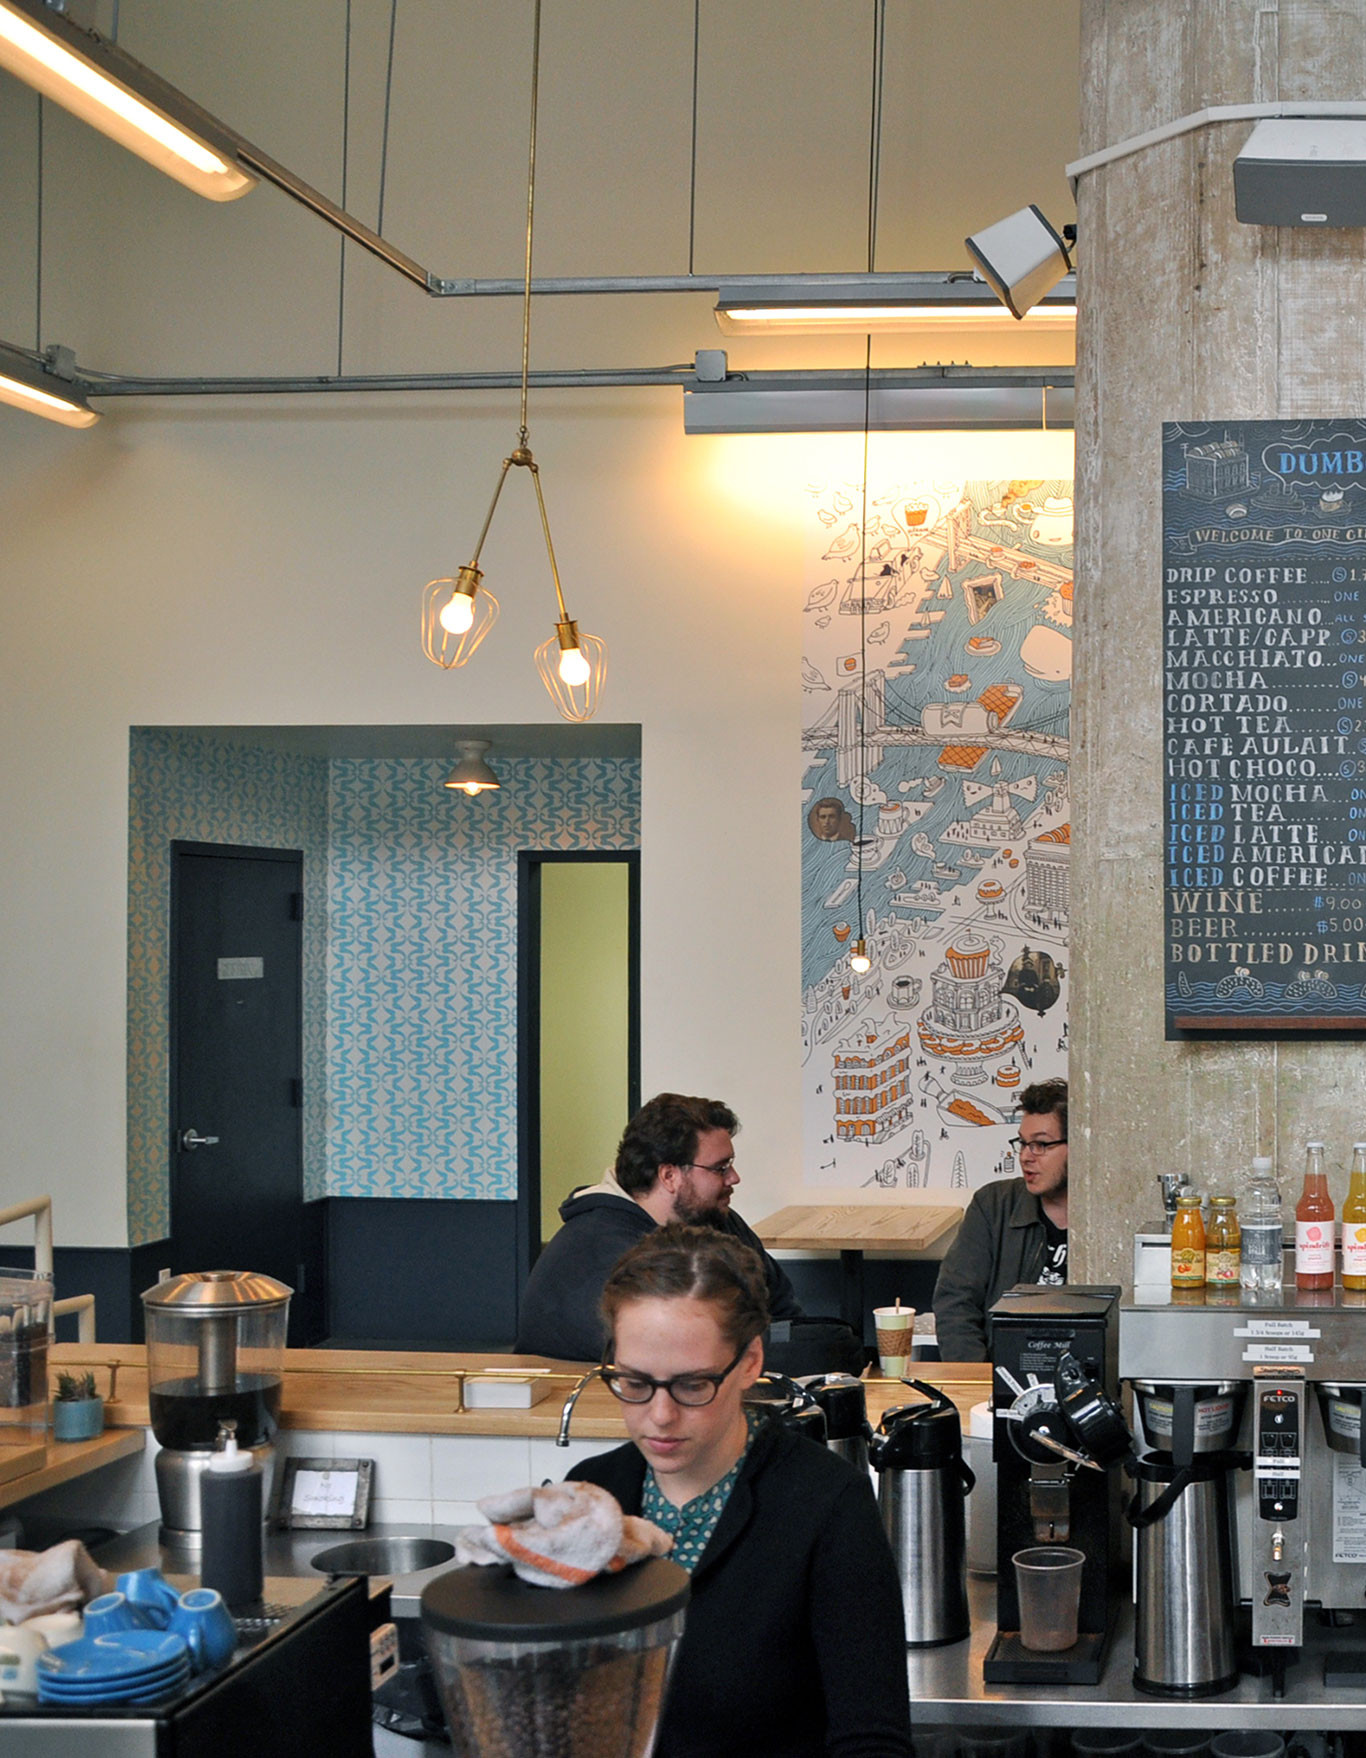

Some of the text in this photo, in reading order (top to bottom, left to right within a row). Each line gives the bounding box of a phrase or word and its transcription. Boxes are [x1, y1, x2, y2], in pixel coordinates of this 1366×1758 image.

[1195, 529, 1275, 542] WELCOME
[1312, 529, 1339, 540] ONE
[1166, 568, 1216, 583] DRIP
[1224, 567, 1307, 584] COFFEE
[1166, 589, 1278, 605] ESPRESSO
[1334, 590, 1360, 602] ONE
[1167, 608, 1322, 626] AMERICANO
[1335, 613, 1356, 623] ALL
[1166, 628, 1331, 647] LATTE/CAPP
[1166, 650, 1322, 668] MACCHIATO
[1339, 653, 1365, 664] ONE
[1166, 671, 1269, 690] MOCHA
[1166, 693, 1288, 713] CORTADO
[1338, 696, 1363, 710] ONE
[1166, 717, 1224, 734] HOT
[1236, 716, 1293, 734] TEA
[1168, 759, 1221, 778] HOT
[1229, 758, 1316, 777] CHOCO
[1170, 783, 1224, 801] ICED
[1231, 784, 1329, 803] MOCHA
[1170, 803, 1223, 822] ICED
[1231, 804, 1287, 822] TEA
[1170, 825, 1225, 843] ICED
[1233, 824, 1319, 844] LATTE
[1167, 845, 1224, 864] ICED
[1170, 868, 1223, 887] ICED
[1233, 867, 1328, 887] COFFEE
[1172, 892, 1263, 914] WINE
[1314, 896, 1362, 911] $9.00
[1171, 919, 1238, 938] BEER
[1316, 917, 1364, 934] $5.00
[1171, 943, 1294, 963] BOTTLED
[1027, 1340, 1072, 1350] Coffee Mill
